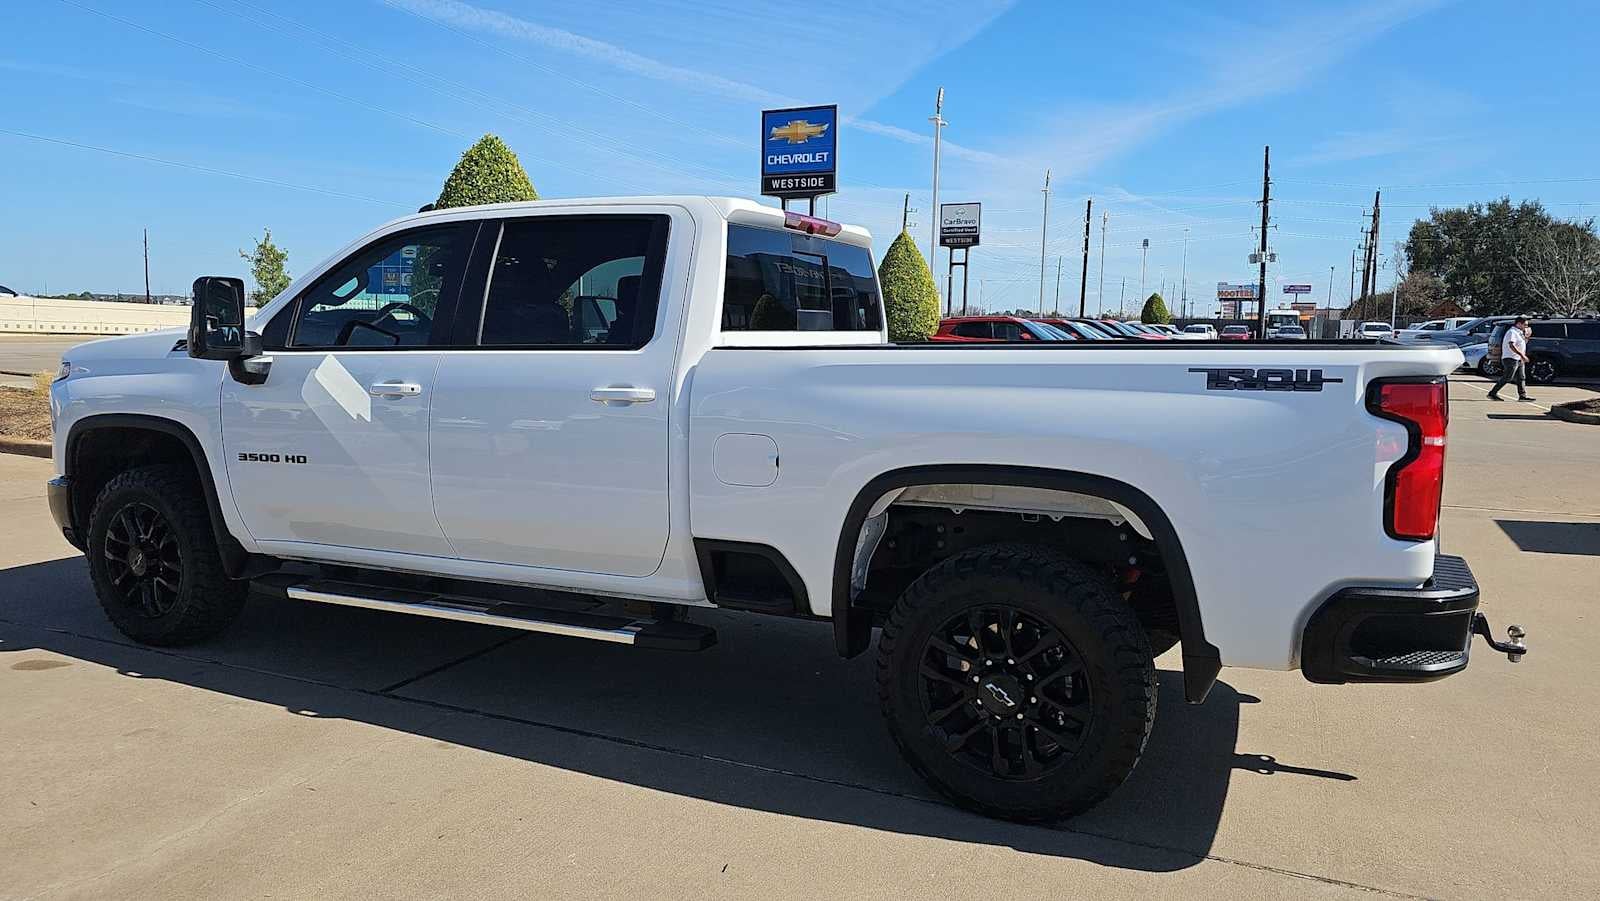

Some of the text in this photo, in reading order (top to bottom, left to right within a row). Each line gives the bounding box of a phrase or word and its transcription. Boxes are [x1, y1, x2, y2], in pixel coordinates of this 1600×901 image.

[768, 152, 829, 165] CHEVROLET
[772, 177, 825, 189] WESTSIDE
[238, 453, 307, 464] 3500 HD
